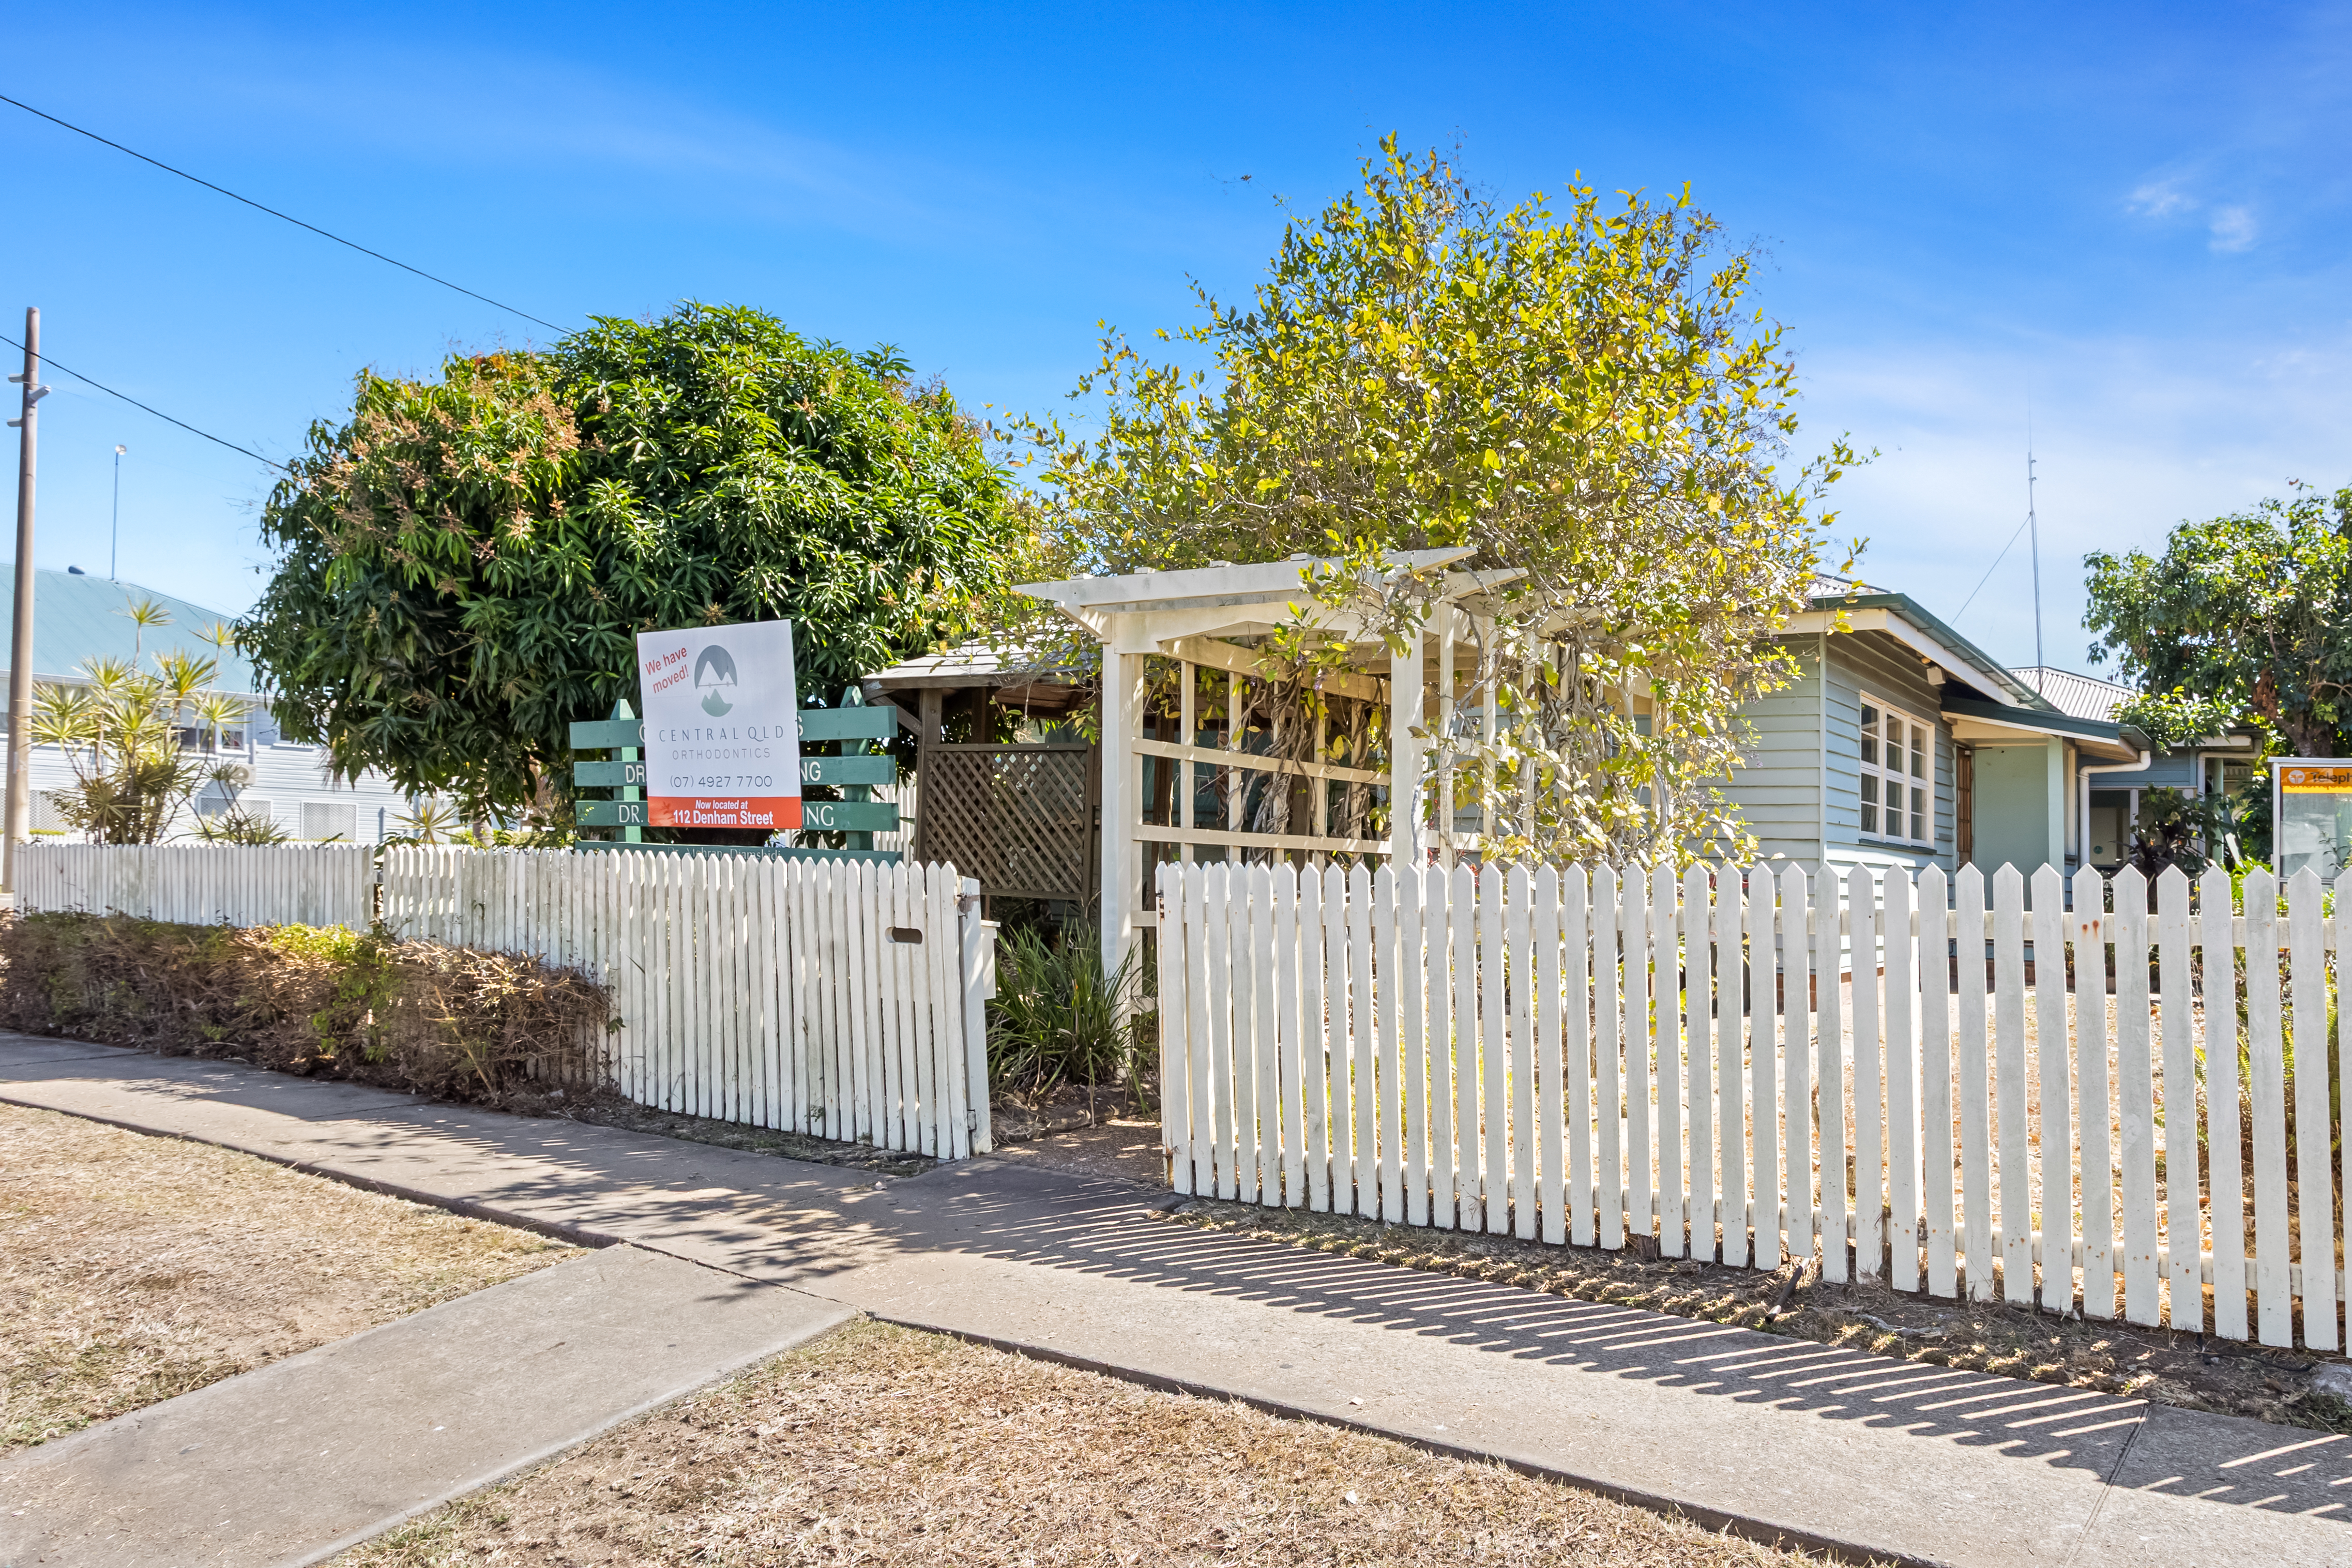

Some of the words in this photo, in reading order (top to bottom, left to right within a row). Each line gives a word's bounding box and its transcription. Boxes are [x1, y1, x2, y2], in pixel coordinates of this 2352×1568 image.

[645, 659, 662, 675] We
[662, 647, 687, 667] have
[653, 664, 689, 694] moved!
[659, 727, 739, 742] CENTRAL
[748, 725, 783, 742] QLD
[672, 748, 770, 760] ORTHODONTICS
[625, 764, 646, 783] DR
[670, 775, 694, 788] (07)
[698, 776, 731, 788] 4927
[737, 775, 772, 787] 7700
[618, 804, 644, 823] DR.
[695, 800, 711, 810] Now
[712, 800, 739, 810] located
[740, 800, 748, 810] at
[673, 810, 691, 824] 112
[693, 810, 737, 824] Denham
[740, 810, 773, 825] Street
